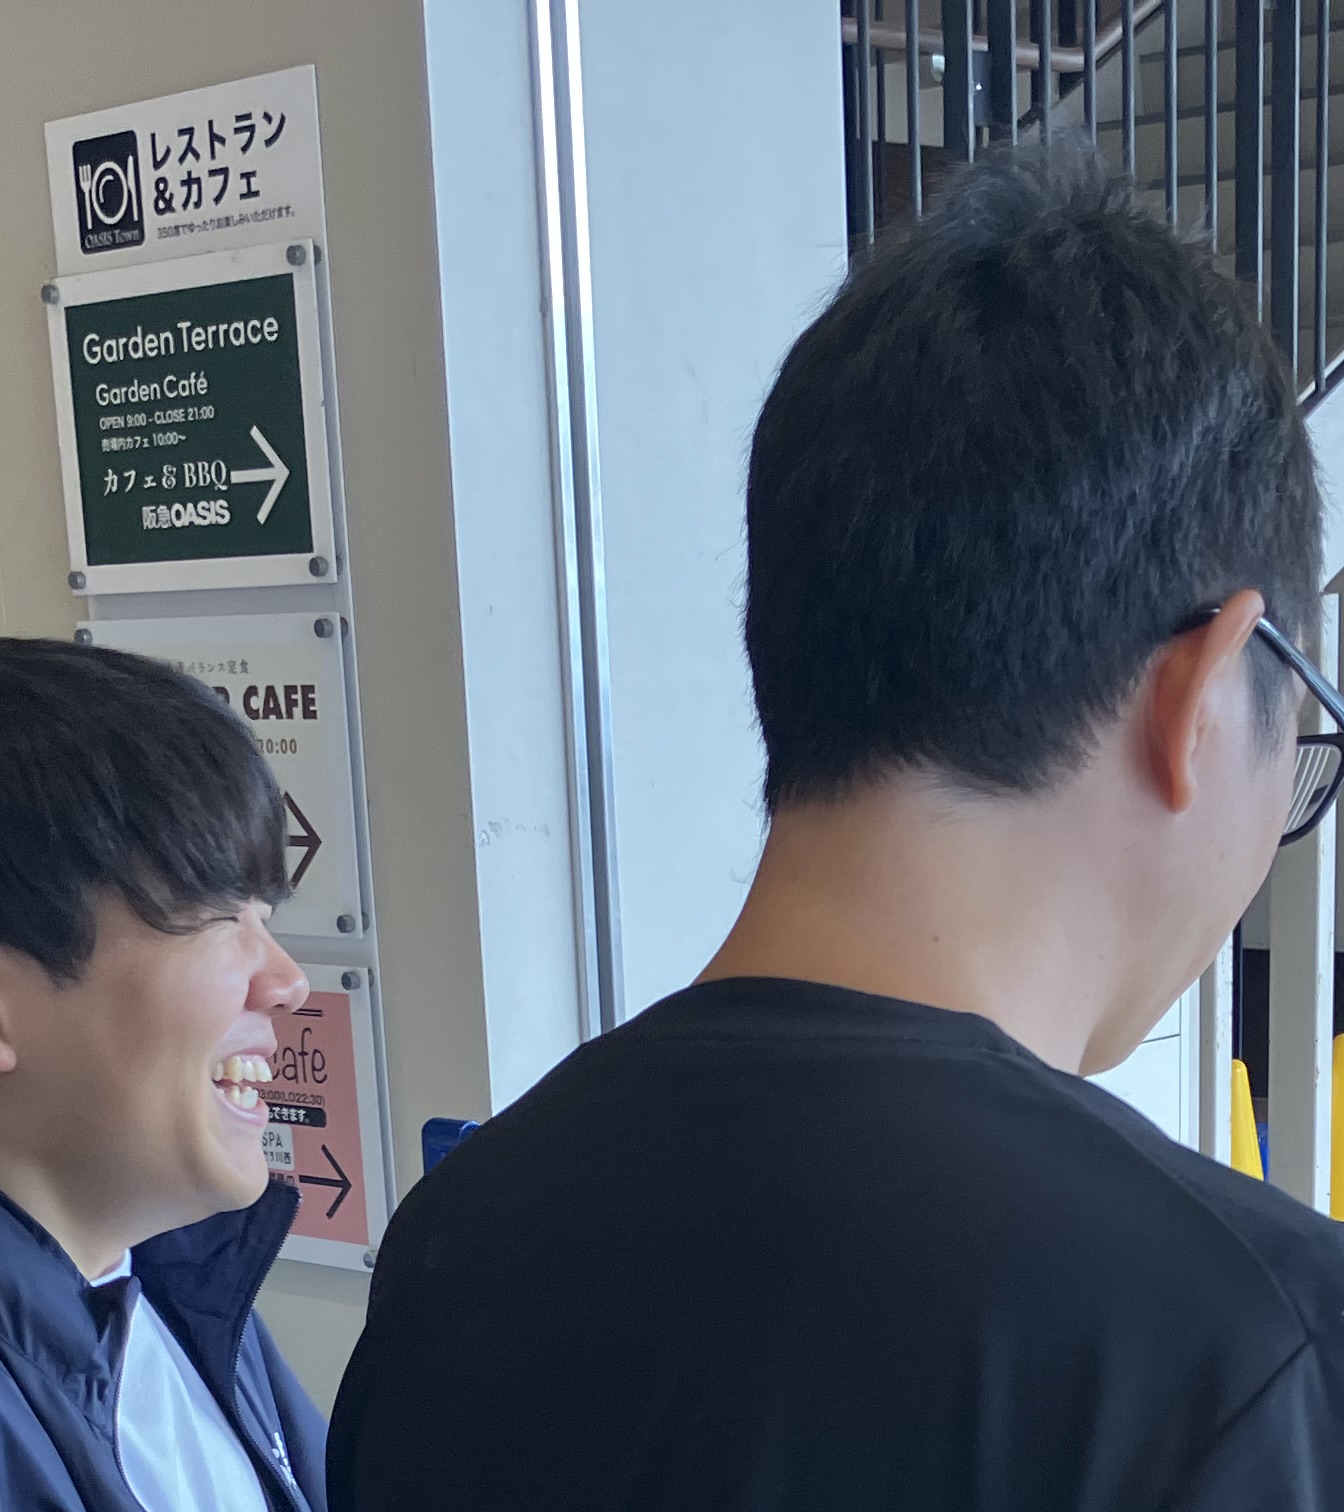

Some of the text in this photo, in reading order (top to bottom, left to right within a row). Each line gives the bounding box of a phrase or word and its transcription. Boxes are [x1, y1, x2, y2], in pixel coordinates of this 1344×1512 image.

[150, 111, 287, 171] レストラン
[154, 166, 260, 216] &カフェ
[84, 228, 141, 249] OASIS Town
[83, 317, 279, 365] Garden Terrace
[96, 371, 208, 406] Garden Café
[99, 414, 125, 430] OPEN
[127, 413, 147, 428] 9:00
[155, 408, 186, 425] CLOSE
[187, 405, 215, 421] 21:00
[103, 468, 157, 497] カフェ
[183, 460, 229, 491] BBQ
[243, 684, 318, 721] CAFE
[261, 1131, 284, 1148] SPA
